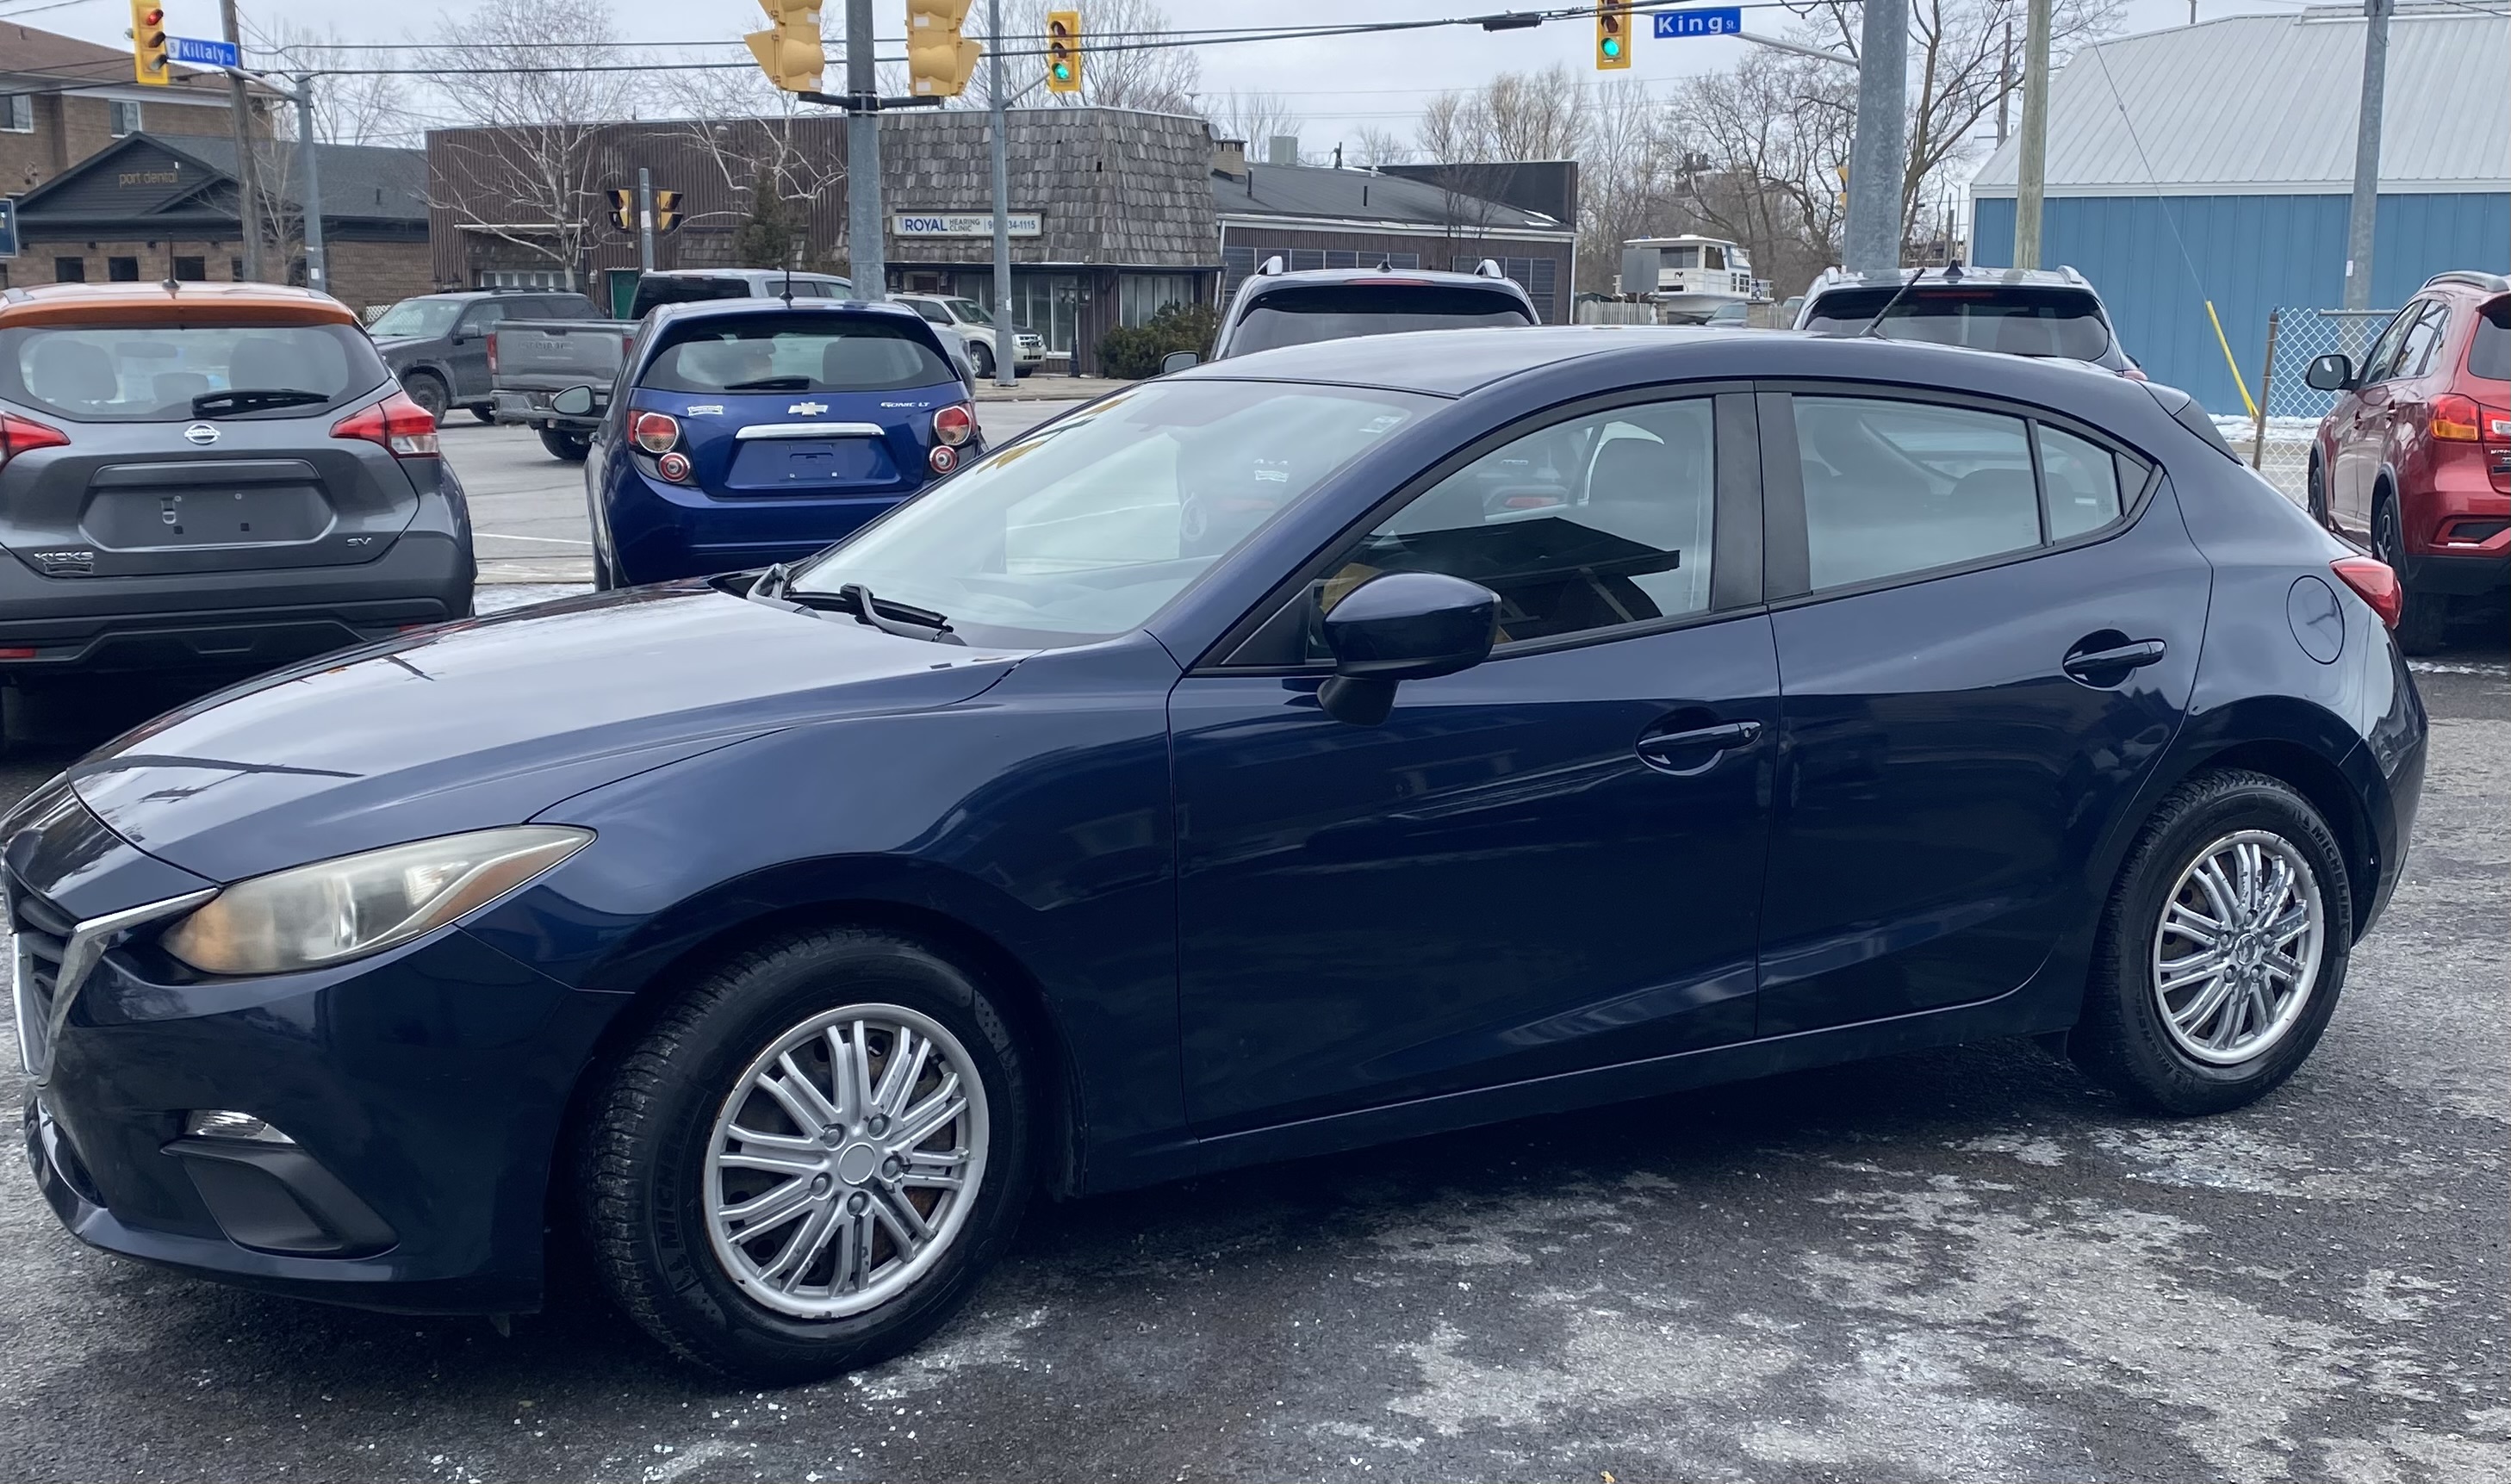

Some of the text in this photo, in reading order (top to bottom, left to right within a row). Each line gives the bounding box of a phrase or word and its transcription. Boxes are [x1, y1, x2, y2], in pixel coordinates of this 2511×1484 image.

[1658, 15, 1722, 34] King
[182, 41, 224, 65] Killaly
[905, 219, 948, 232] ROYAL
[347, 537, 372, 546] SV
[34, 551, 94, 563] KICKS
